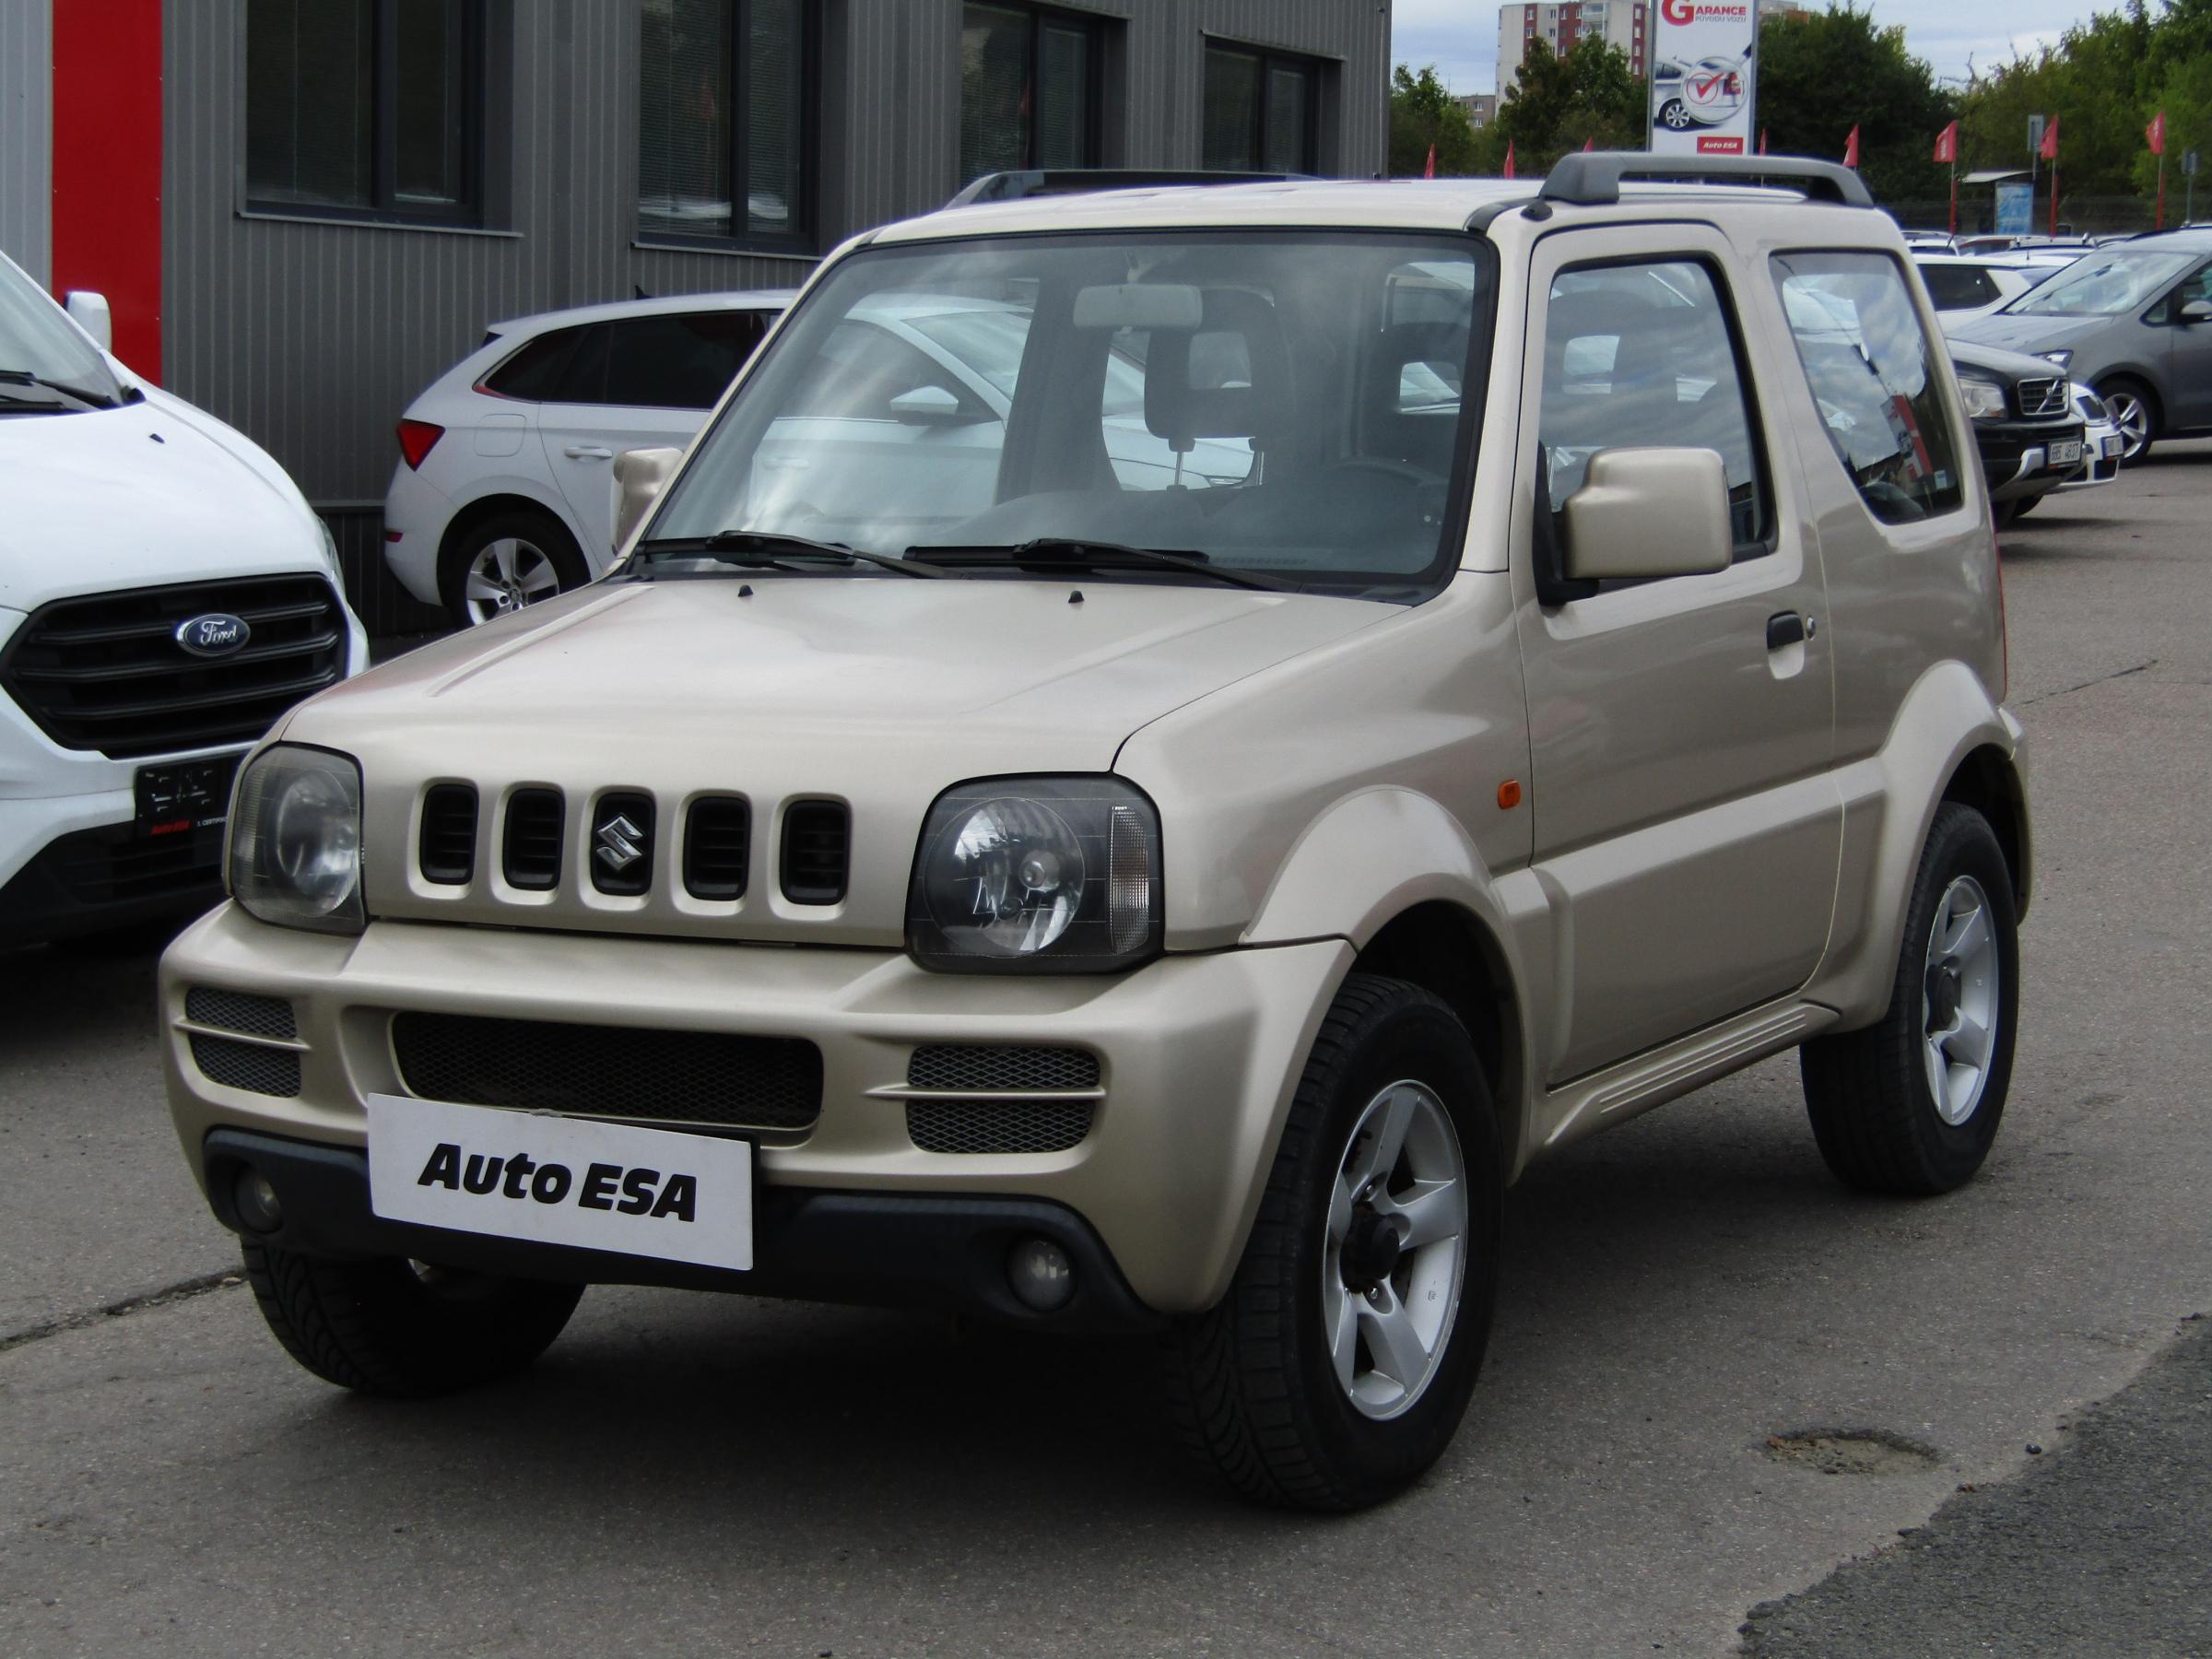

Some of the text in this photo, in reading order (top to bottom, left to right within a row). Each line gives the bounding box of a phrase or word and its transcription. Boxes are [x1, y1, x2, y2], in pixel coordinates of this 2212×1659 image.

[1662, 0, 1747, 26] GARANCE
[200, 620, 237, 645] Ford
[418, 1143, 697, 1223] Auto ESA
